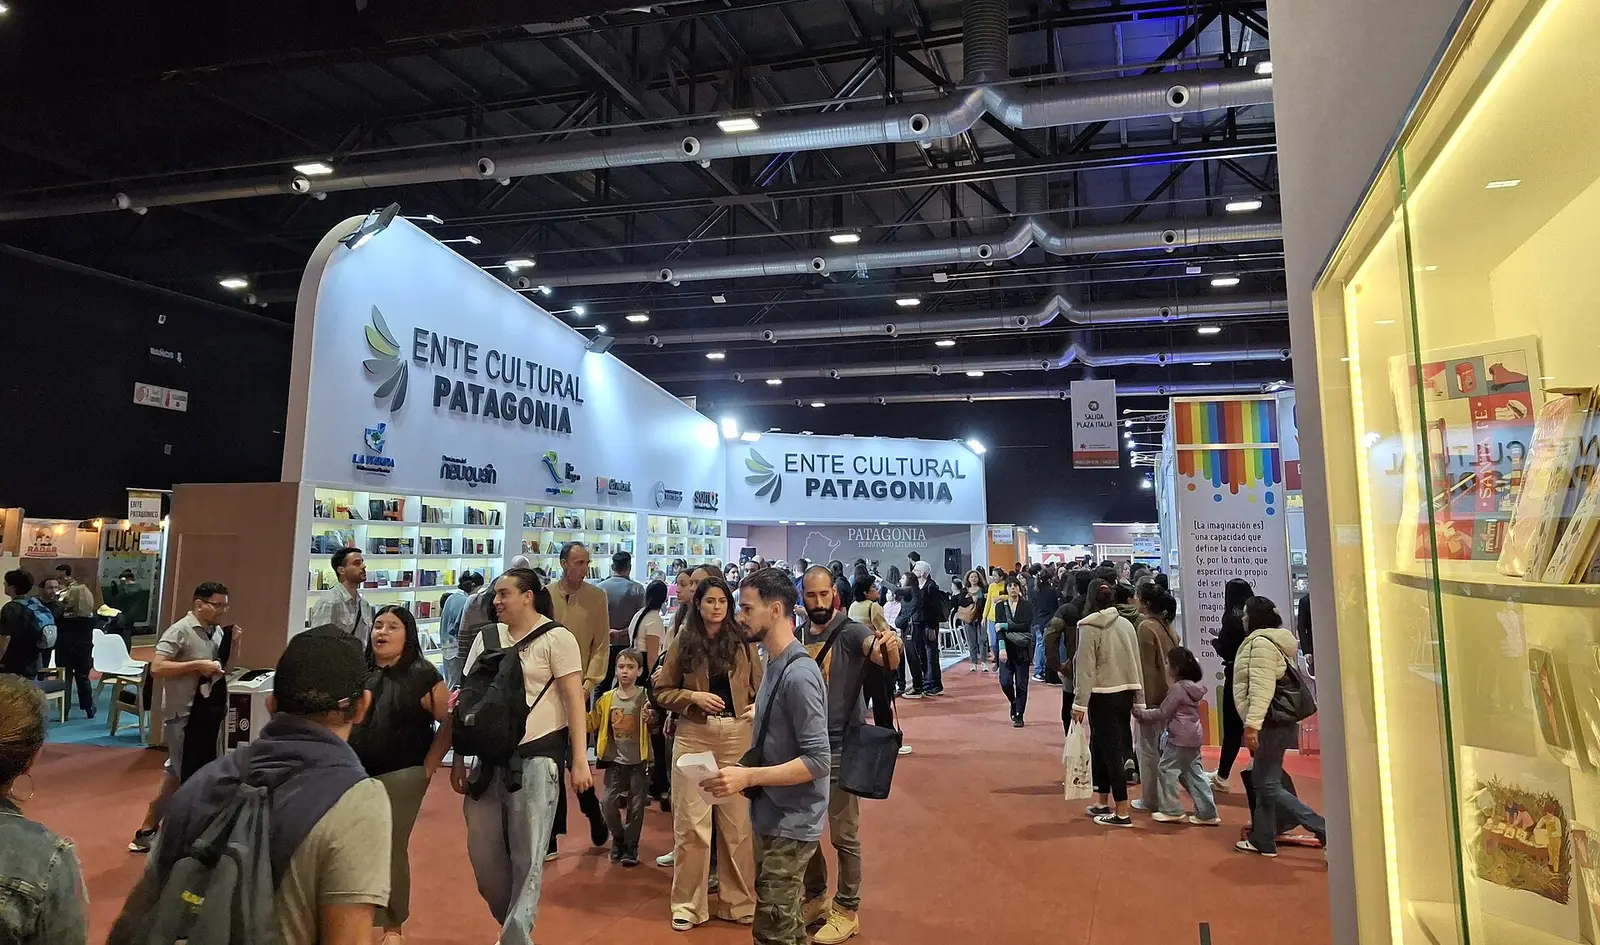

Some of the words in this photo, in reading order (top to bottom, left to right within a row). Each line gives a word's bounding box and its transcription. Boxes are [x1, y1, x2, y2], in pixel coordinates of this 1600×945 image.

[412, 327, 479, 375] ENTE
[485, 349, 584, 404] CULTURAL
[432, 374, 572, 434] PATAGONIA
[1475, 409, 1489, 430] FE
[784, 453, 844, 473] ENTE
[853, 455, 966, 479] CULTURAL
[1479, 436, 1493, 498] SANTA
[805, 478, 953, 503] PATAGONIA
[1194, 520, 1205, 530] [La
[1207, 521, 1251, 531] imaginación
[1252, 520, 1264, 530] es]
[848, 528, 927, 541] PATAGONIA
[1210, 533, 1246, 542] capacidad
[1248, 534, 1262, 542] que
[1195, 544, 1219, 552] define
[1220, 544, 1227, 552] la
[1206, 557, 1219, 565] por
[1221, 555, 1229, 564] lo
[1254, 557, 1268, 565] que
[1196, 568, 1234, 577] especifica
[1235, 568, 1242, 576] lo
[1244, 568, 1268, 577] propio
[1197, 579, 1209, 587] del
[1198, 590, 1207, 599] En
[1209, 590, 1225, 599] tant
[1199, 614, 1220, 622] modo
[1200, 626, 1207, 634] el
[1202, 650, 1215, 658] con
